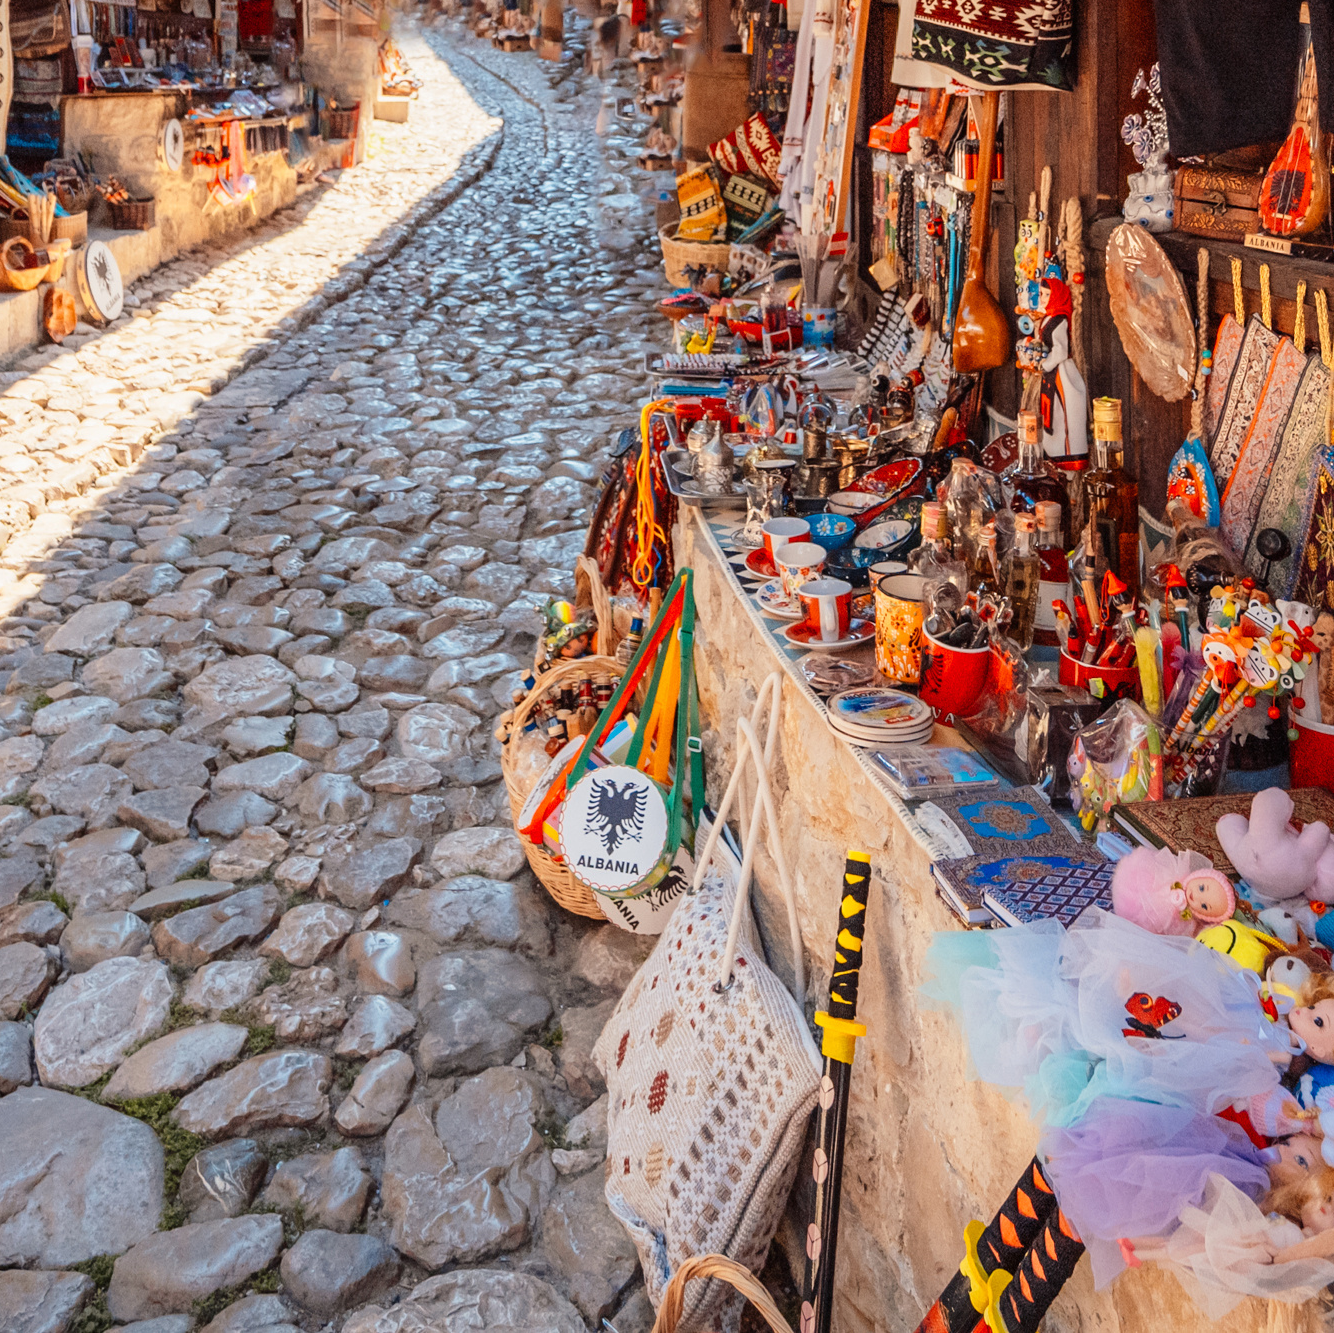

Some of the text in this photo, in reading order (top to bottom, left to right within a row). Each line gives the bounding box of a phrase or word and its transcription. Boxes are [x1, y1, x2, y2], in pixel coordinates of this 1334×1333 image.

[1249, 237, 1285, 251] ALBANIA
[577, 854, 640, 876] ALBANIA
[612, 898, 640, 931] ANIA
